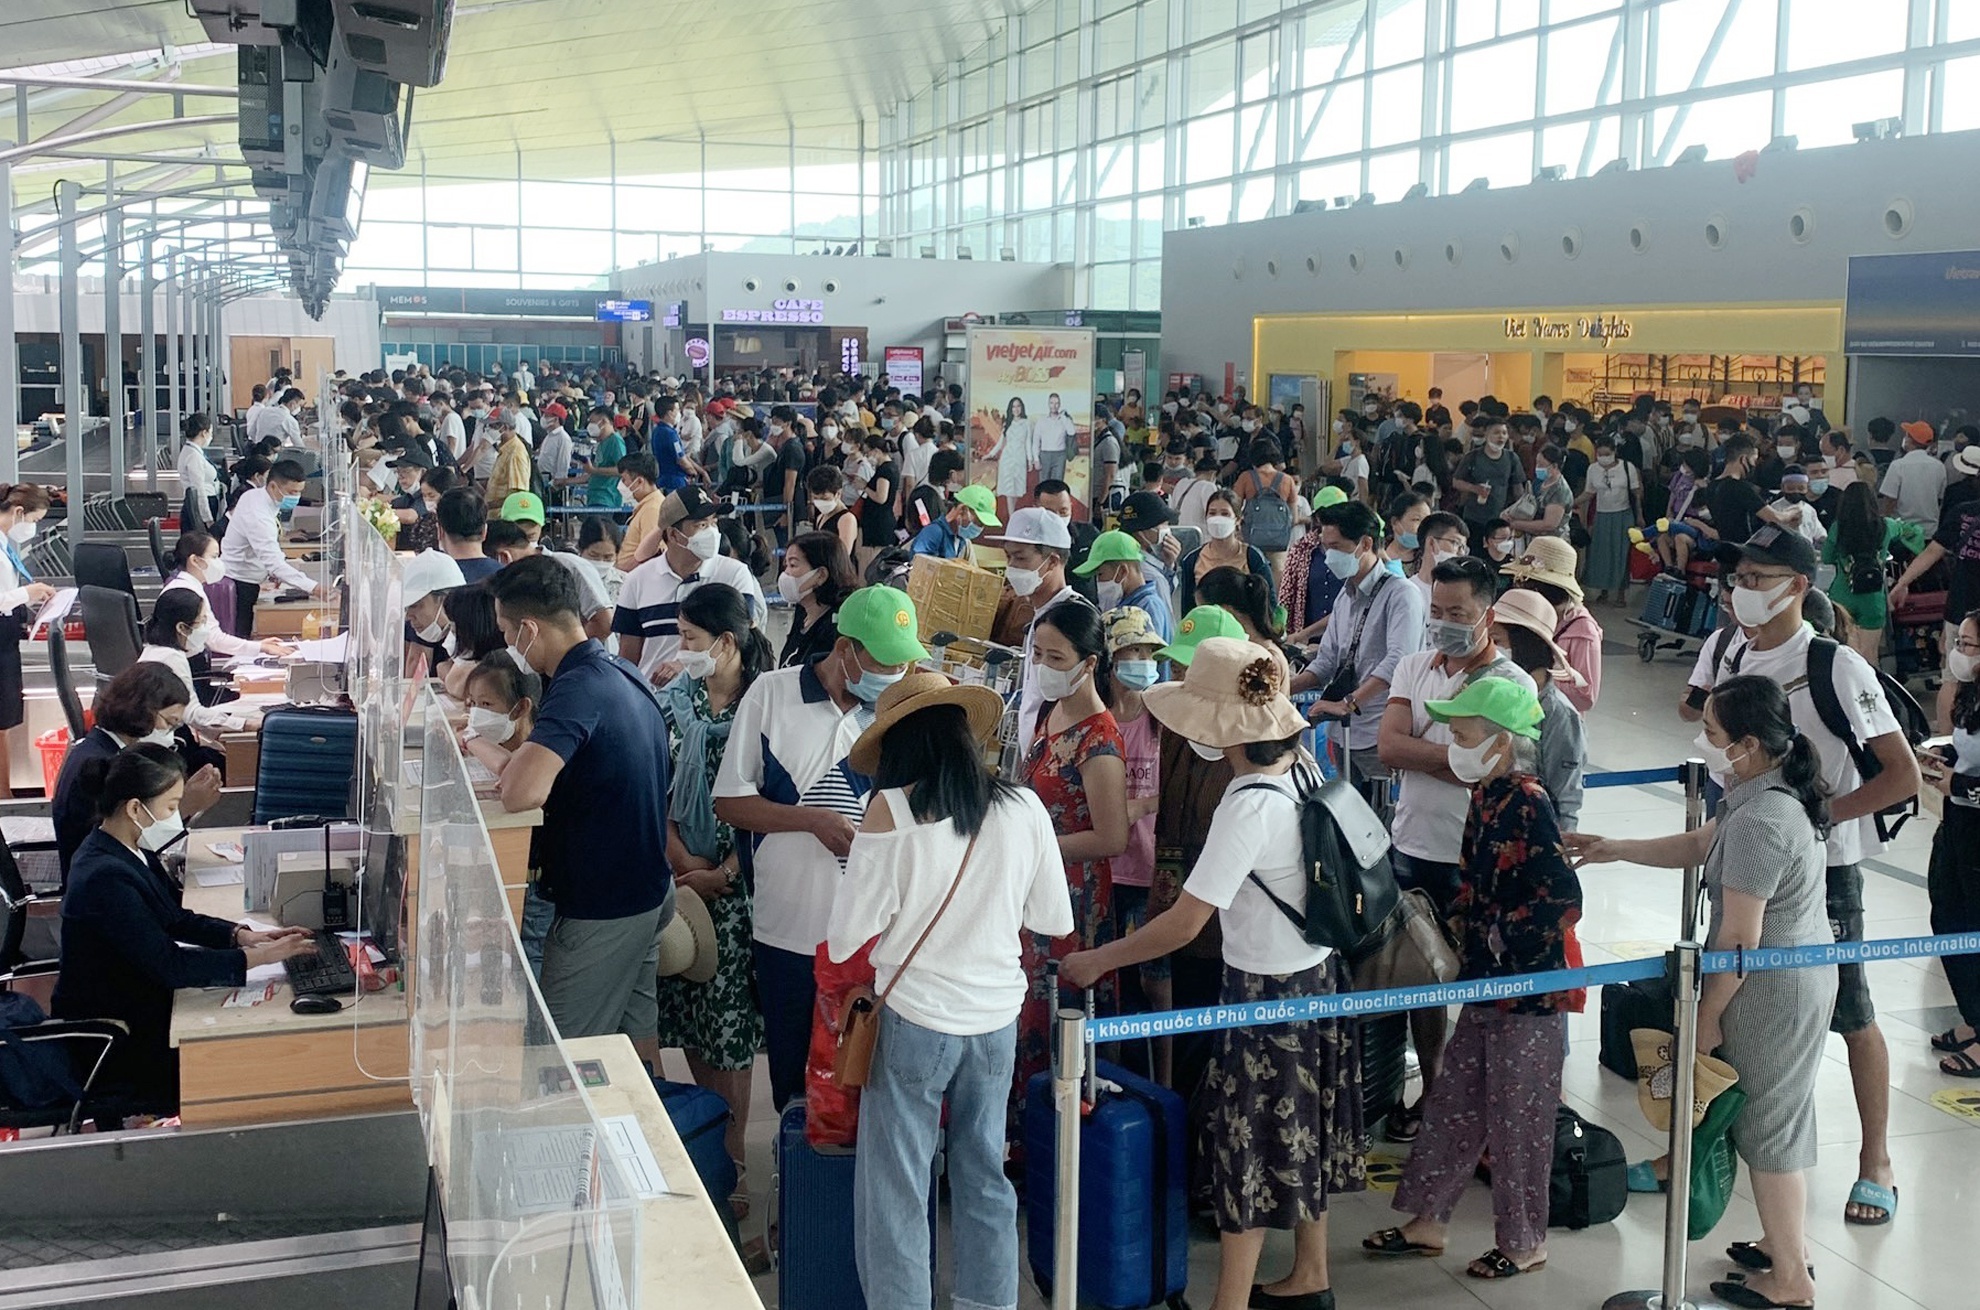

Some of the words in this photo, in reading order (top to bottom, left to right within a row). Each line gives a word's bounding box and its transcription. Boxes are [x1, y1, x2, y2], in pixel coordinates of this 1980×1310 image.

[389, 295, 428, 304] MEMOS
[774, 299, 824, 310] CAFE
[722, 309, 824, 323] ESPRESSO
[1504, 316, 1527, 338] Viet
[1577, 314, 1633, 348] Delights
[1826, 942, 1856, 962] Phu
[1860, 941, 1899, 961] Quoc
[1099, 1018, 1151, 1039] không
[1153, 1010, 1193, 1034] quốc
[1197, 1008, 1212, 1026] tế
[1216, 1007, 1247, 1024] Phú
[1254, 1001, 1296, 1022] Quốc
[1308, 1000, 1338, 1014] Phu
[1341, 995, 1382, 1012] Quoc
[1384, 981, 1481, 1007] International
[1483, 977, 1534, 999] Airport
